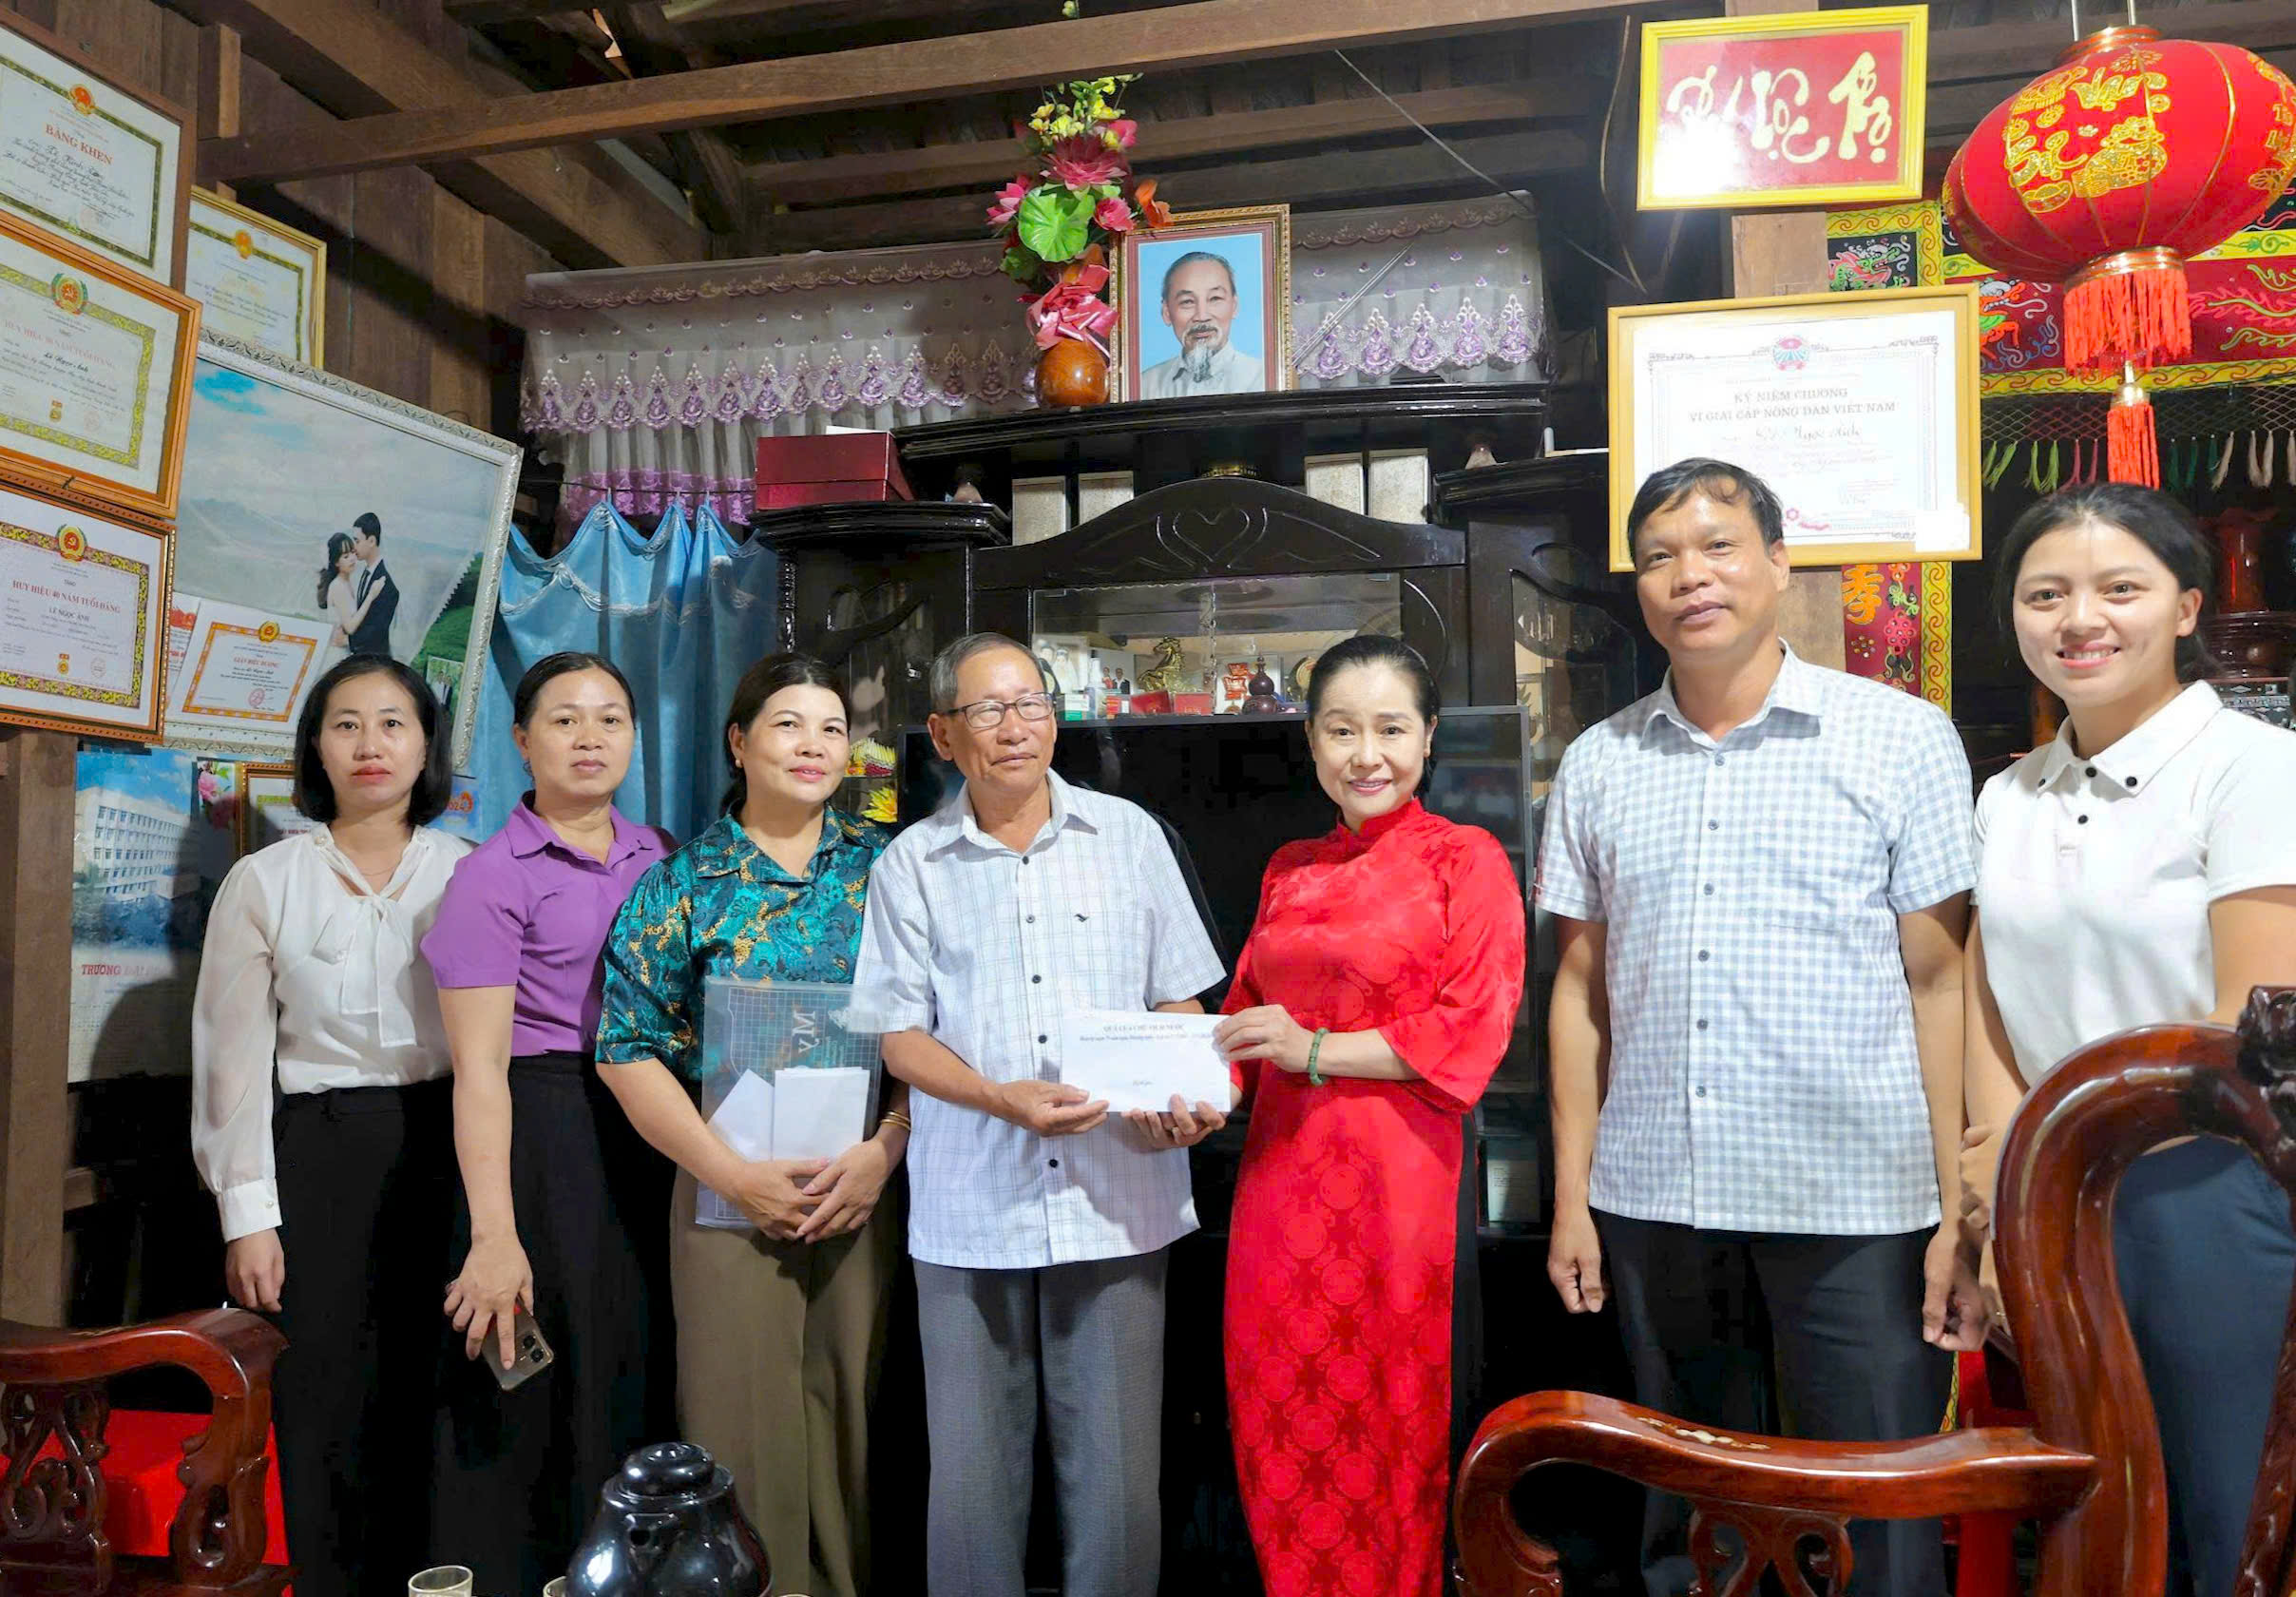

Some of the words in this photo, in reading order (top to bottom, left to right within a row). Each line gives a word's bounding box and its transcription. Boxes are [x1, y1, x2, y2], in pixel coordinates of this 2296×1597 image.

[80, 142, 113, 164] KHEN
[1866, 400, 1897, 413] NAM
[12, 580, 29, 591] HUY
